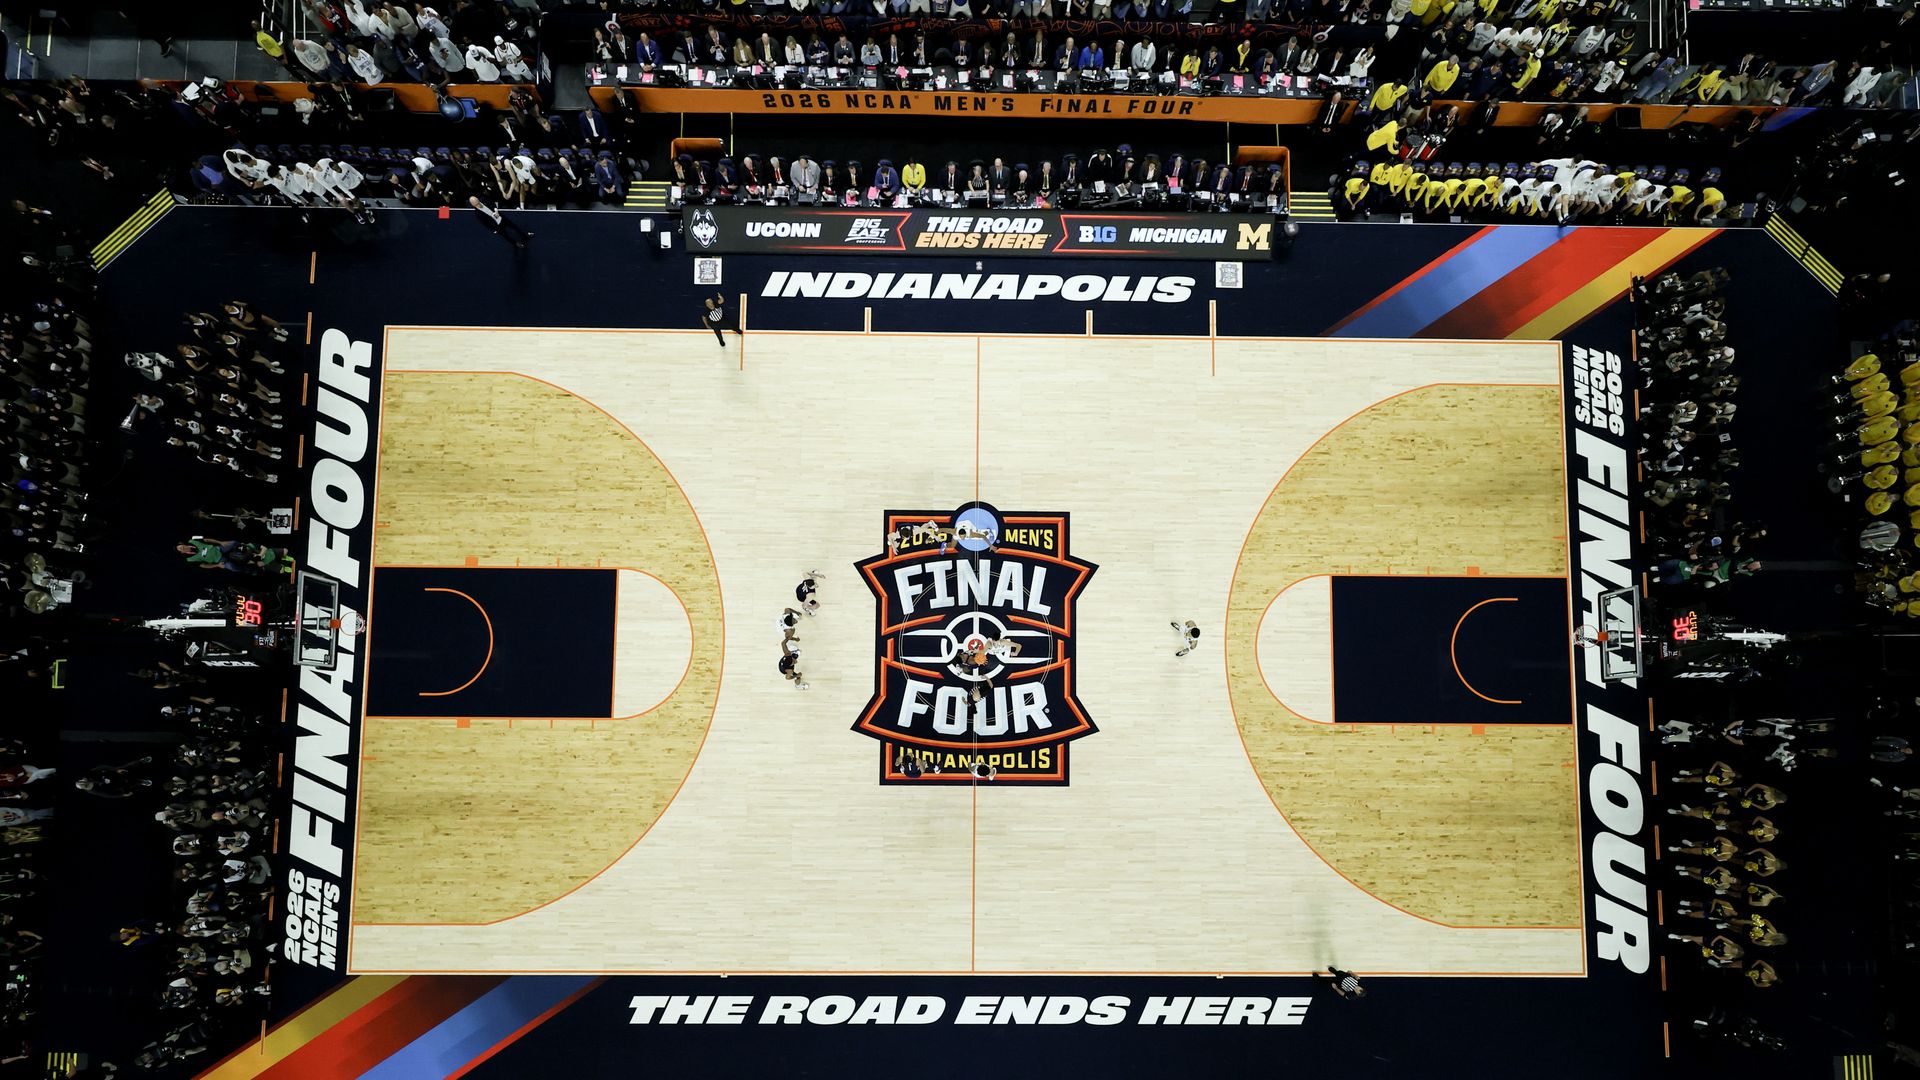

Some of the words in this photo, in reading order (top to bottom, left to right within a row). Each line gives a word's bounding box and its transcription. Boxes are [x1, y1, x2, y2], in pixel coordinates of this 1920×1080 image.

[763, 93, 831, 109] 2026
[845, 94, 912, 110] NCAA
[934, 95, 1015, 112] MEN'S
[1040, 97, 1112, 114] FINAL
[1127, 98, 1194, 115] FOUR
[745, 221, 822, 239] UCONN
[847, 228, 890, 238] EAST
[852, 218, 882, 228] BIG
[915, 232, 981, 248] ENDS
[982, 233, 1049, 249] HERE
[927, 216, 973, 232] THE
[975, 217, 1044, 233] ROAD
[1129, 227, 1227, 244] MICHIGAN
[1236, 223, 1271, 250] M
[761, 271, 1196, 303] INDIANAPOLIS
[1572, 344, 1591, 425] MEN'S
[1589, 348, 1610, 430] NCAA
[1605, 350, 1625, 437] 2026
[307, 328, 372, 588] FOUR
[1005, 528, 1053, 550] MEN'S
[1575, 428, 1637, 690] FINAL
[894, 558, 1052, 616] FINAL
[1673, 616, 1690, 641] 30
[897, 679, 1053, 736] FOUR
[289, 602, 357, 878] FINAL
[1586, 703, 1650, 975] FOUR
[284, 868, 305, 965] 2026
[302, 877, 323, 968] NCAA
[320, 880, 341, 971] MEN'S
[629, 995, 754, 1025] THE
[758, 995, 946, 1026] ROAD
[954, 995, 1131, 1026] ENDS
[1137, 995, 1312, 1026] HERE
